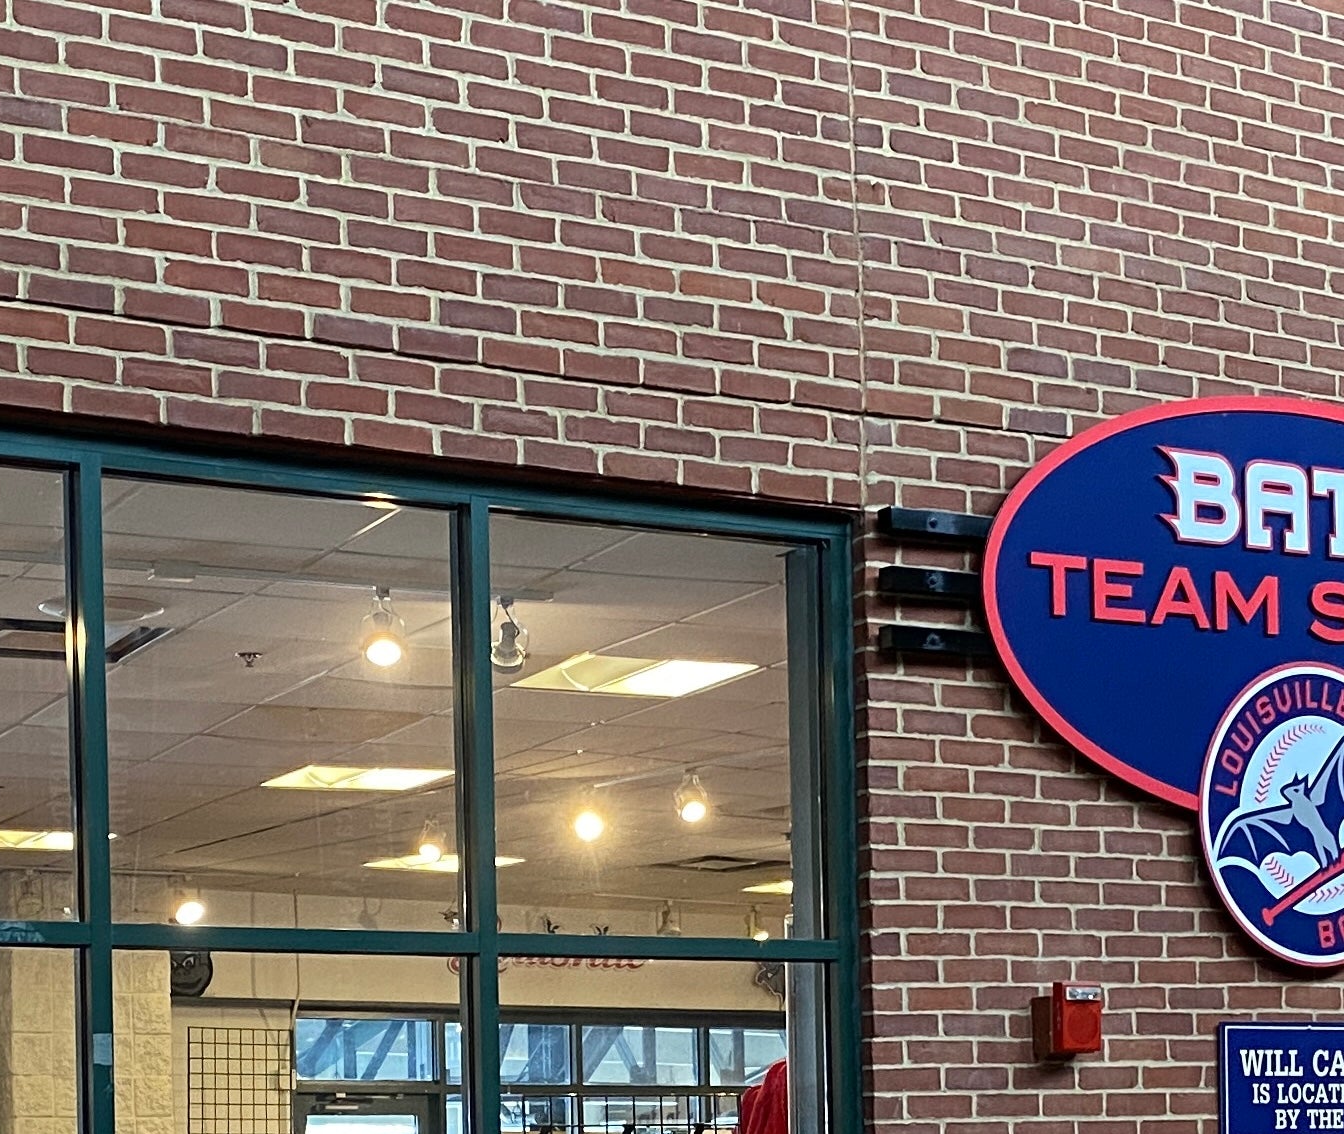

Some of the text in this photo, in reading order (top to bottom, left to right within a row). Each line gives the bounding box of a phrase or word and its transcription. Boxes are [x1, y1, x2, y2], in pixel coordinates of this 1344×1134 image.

[1030, 551, 1280, 636] TEAM
[1240, 1049, 1304, 1077] WILL
[1252, 1083, 1270, 1104] IS
[1274, 1109, 1344, 1131] BY THE
